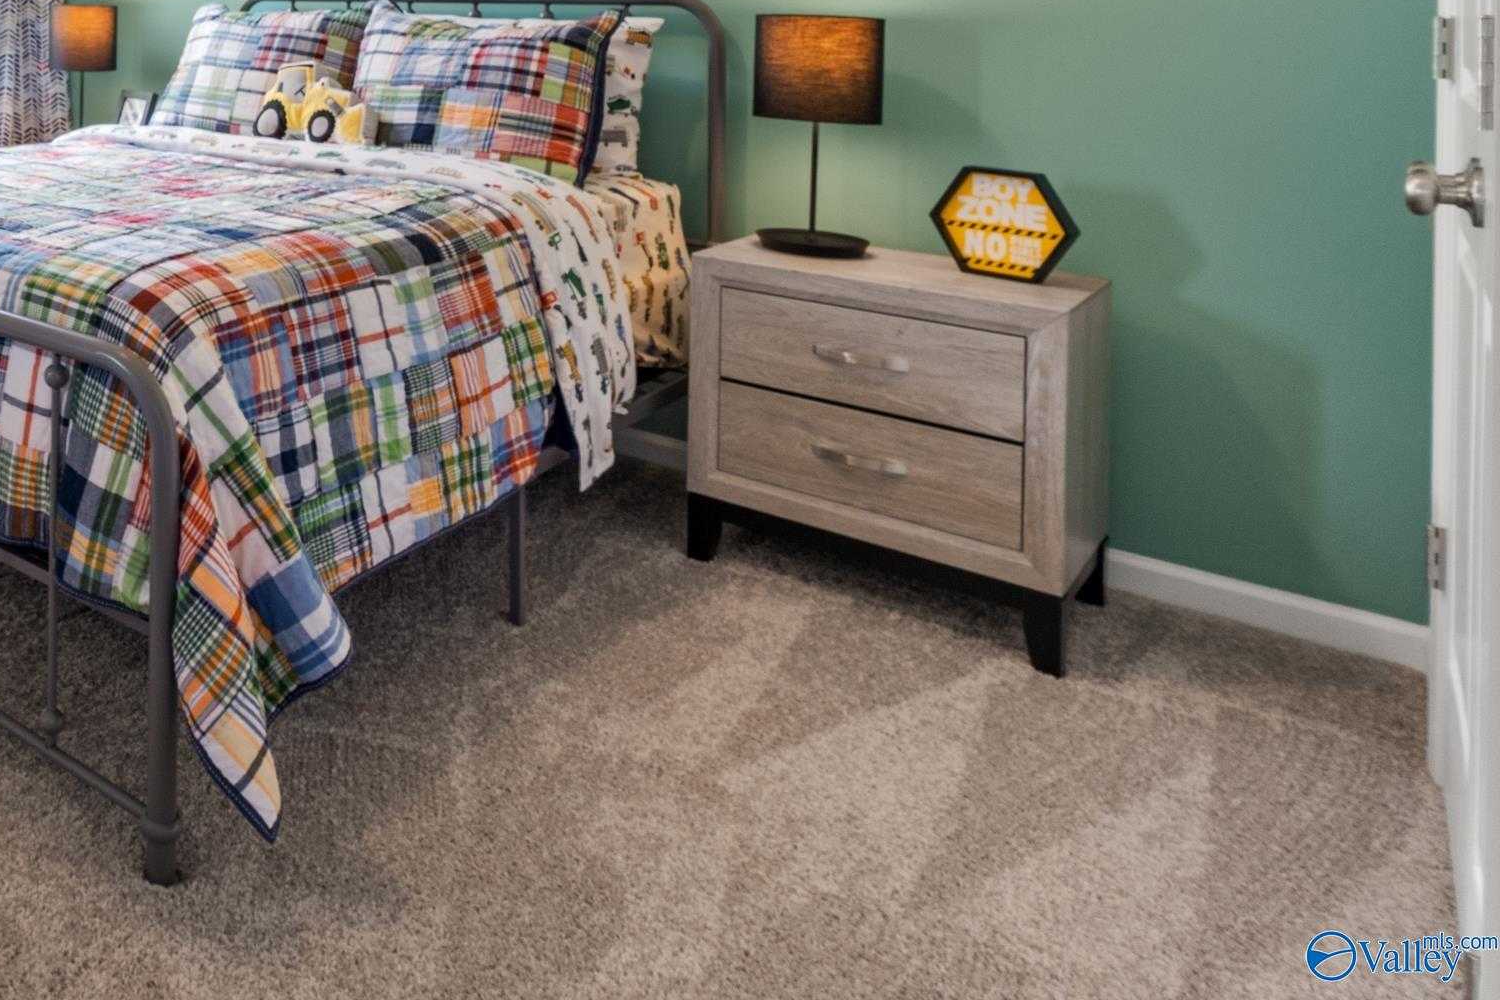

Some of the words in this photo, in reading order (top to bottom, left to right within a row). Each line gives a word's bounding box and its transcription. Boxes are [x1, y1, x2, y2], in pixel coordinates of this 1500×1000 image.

[973, 173, 1035, 202] BOY
[956, 195, 1047, 232] ZONE
[964, 229, 1006, 261] NO
